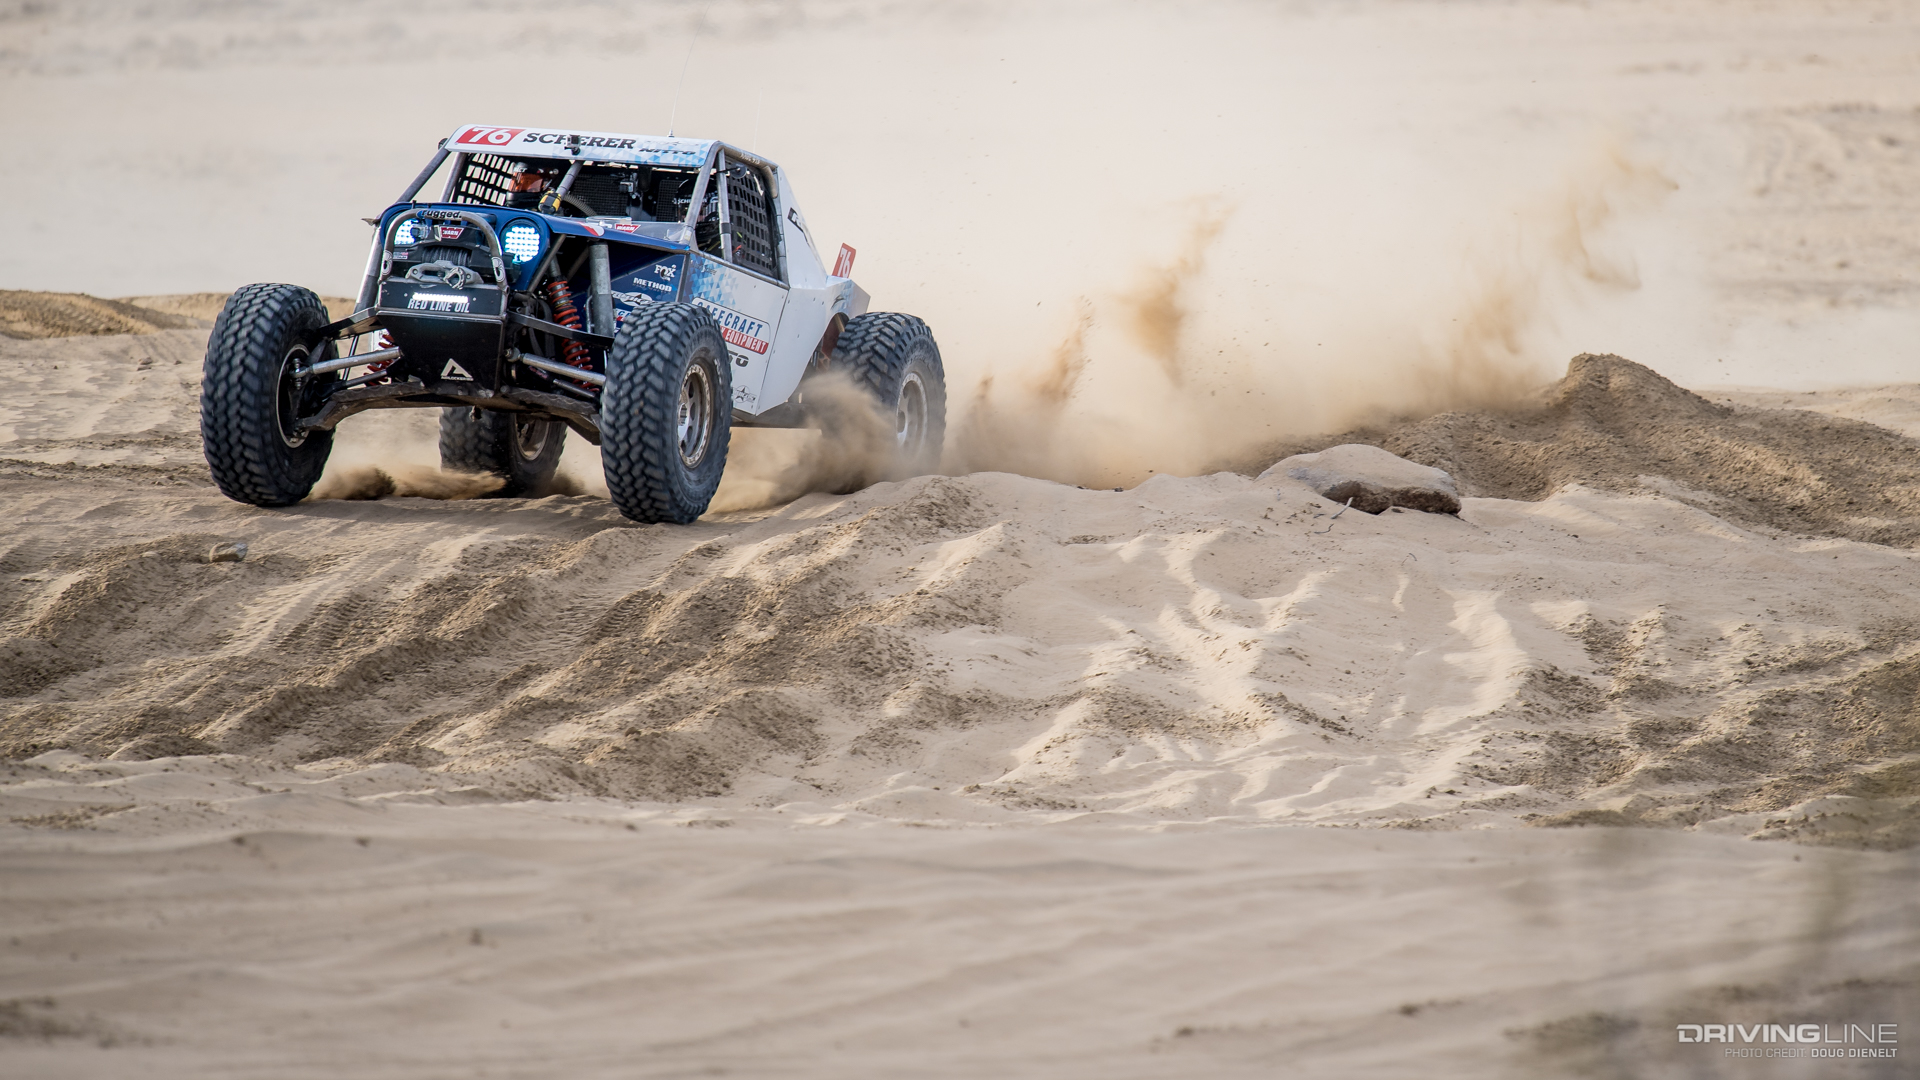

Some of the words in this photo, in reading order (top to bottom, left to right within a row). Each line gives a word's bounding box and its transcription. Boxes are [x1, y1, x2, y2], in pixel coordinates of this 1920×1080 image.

[470, 127, 512, 144] 76
[837, 247, 852, 278] 76
[654, 264, 676, 280] FOX
[633, 277, 672, 292] METHOD
[407, 298, 428, 310] RED
[429, 300, 452, 312] LINE
[454, 302, 470, 313] OIL
[724, 329, 767, 353] EQUIPMENT
